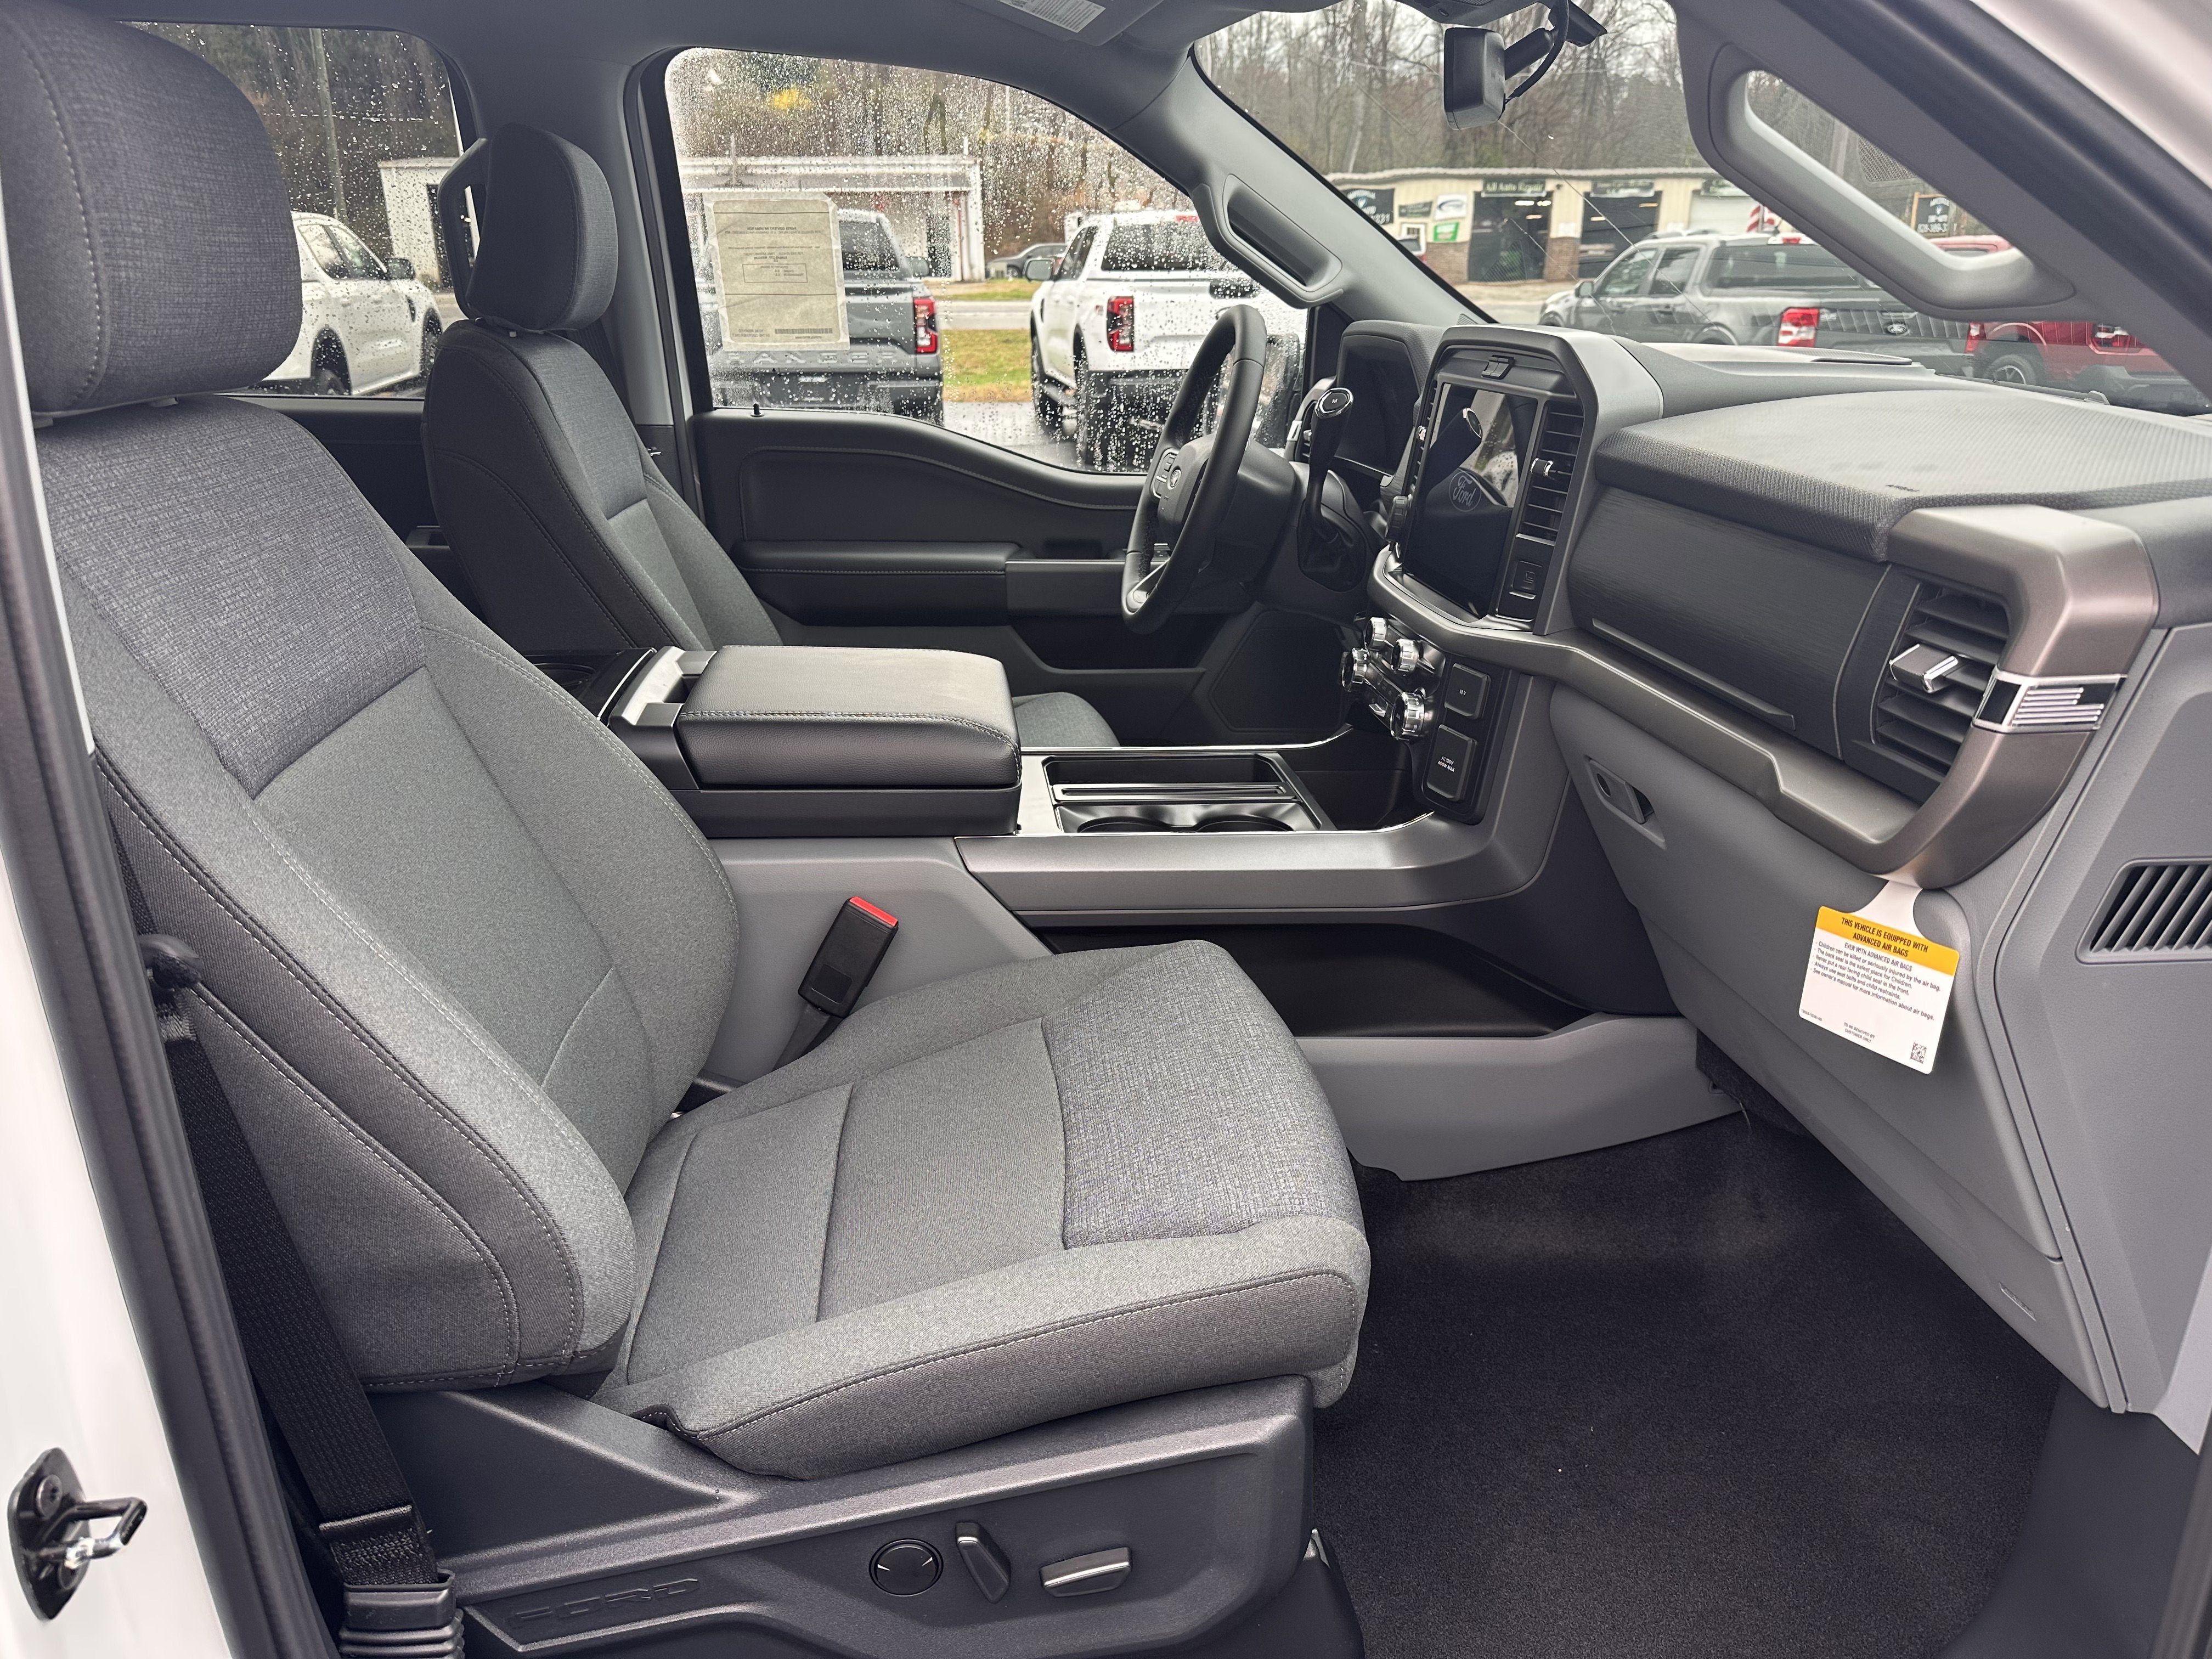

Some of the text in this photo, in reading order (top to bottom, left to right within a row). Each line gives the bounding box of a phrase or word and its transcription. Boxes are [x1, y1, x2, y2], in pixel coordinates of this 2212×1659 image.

[726, 352, 898, 365] RANGER
[1452, 475, 1477, 507] Ford
[1842, 917, 1853, 927] THIS
[1854, 921, 1876, 935] VEHICLE
[1883, 932, 1911, 947] EQUIPPED
[1912, 941, 1928, 952] WITH
[1853, 932, 1909, 957] ADVANCED AIR BAGS
[1814, 961, 1828, 970] Always
[1816, 955, 1827, 963] Never
[1847, 967, 1860, 977] facing
[1861, 973, 1872, 981] child
[1819, 941, 1835, 951] Children
[1849, 953, 1861, 962] killed
[1867, 960, 1888, 973] seriously
[1889, 968, 1905, 978] injured
[1825, 951, 1835, 959] back
[1857, 964, 1870, 973] safest
[1844, 942, 1855, 951] EVEN
[1856, 947, 1866, 955] WITH
[1867, 951, 1890, 964] ADVANCED
[1900, 962, 1912, 972] BAGS
[1837, 978, 1852, 988] manual
[1871, 992, 1897, 1006] information
[1898, 1003, 1912, 1012] about
[506, 1578, 700, 1629] FORD
